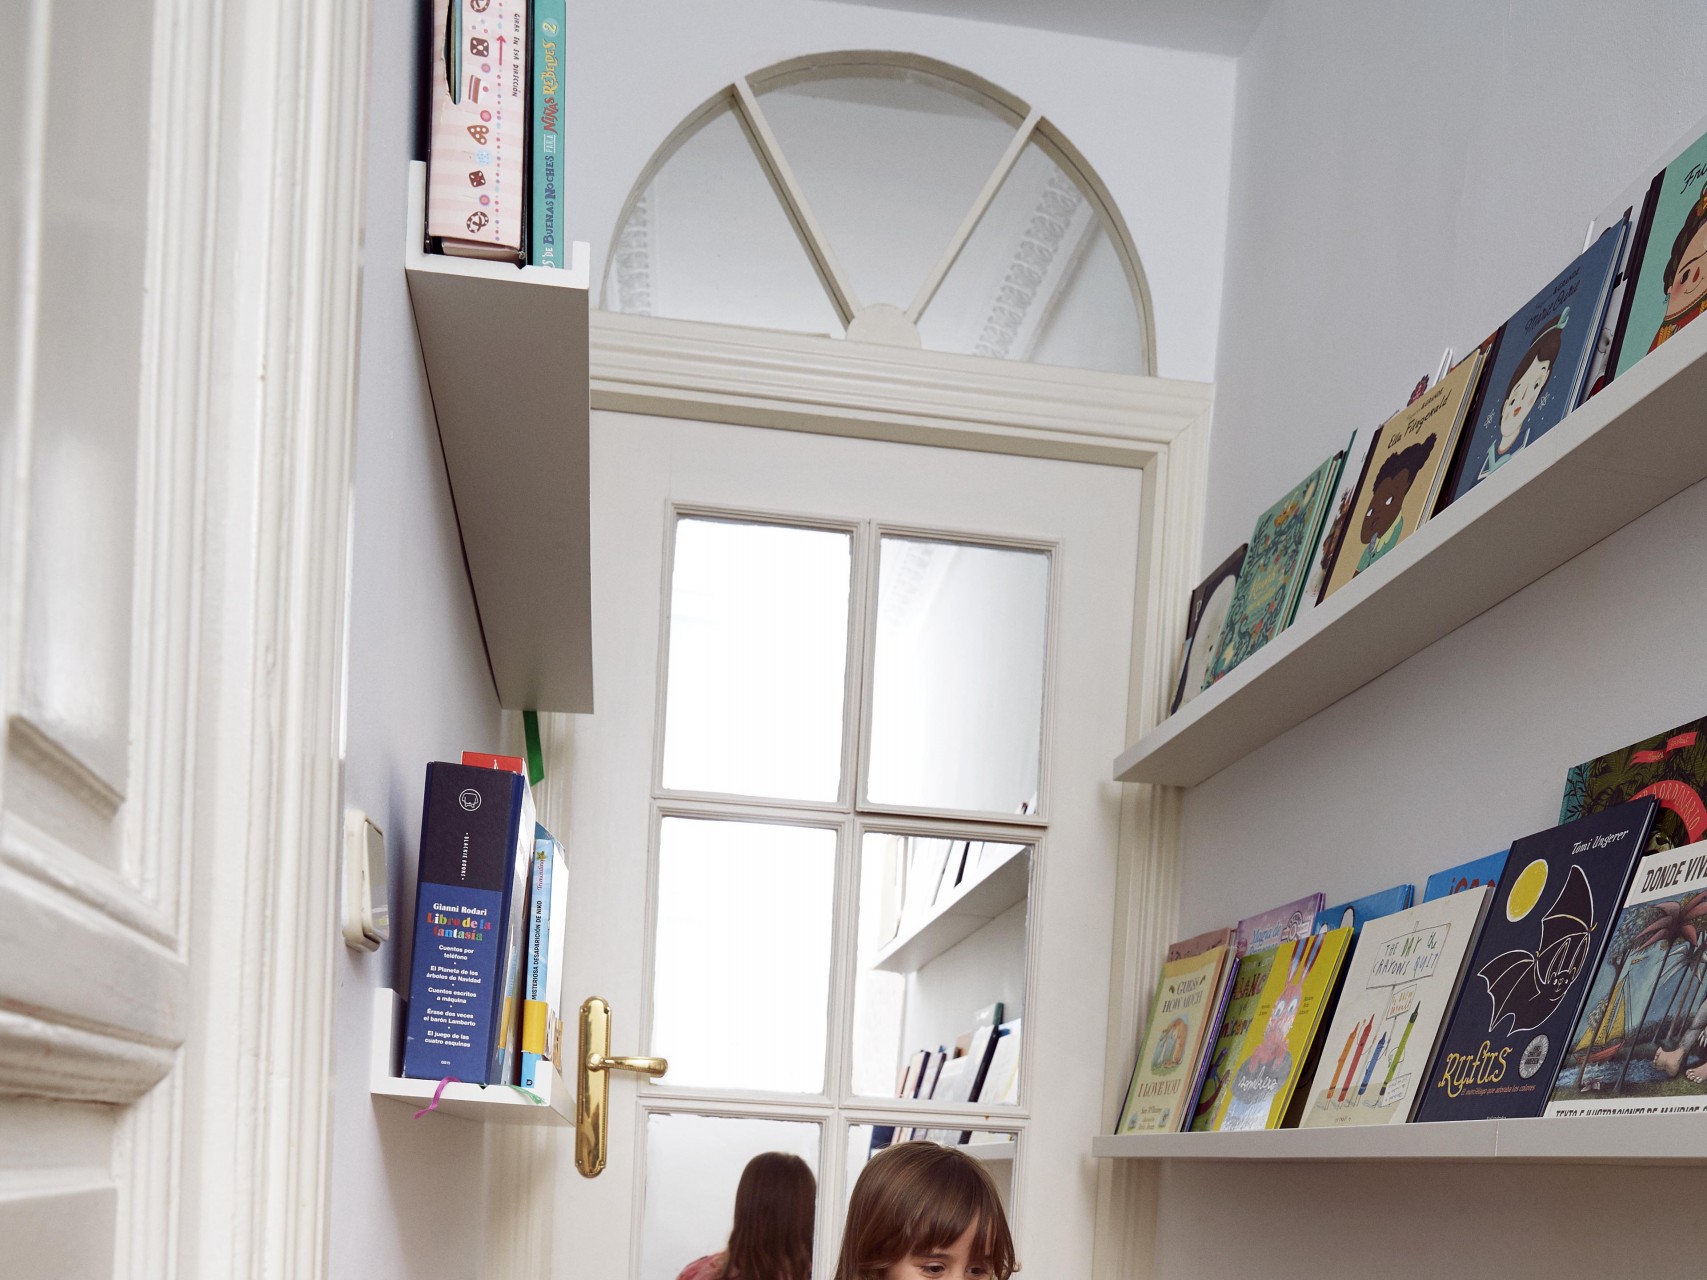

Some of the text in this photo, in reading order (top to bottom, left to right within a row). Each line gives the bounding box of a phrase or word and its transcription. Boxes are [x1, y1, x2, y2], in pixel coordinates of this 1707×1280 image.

[543, 22, 557, 34] 2
[542, 38, 558, 95] REBELDES
[545, 155, 555, 200] NOCHES
[543, 200, 554, 245] BUENAS
[1571, 830, 1629, 855] Tomi Ungerer
[1641, 861, 1687, 894] DONDE
[433, 902, 487, 916] Gianni Rodari
[427, 912, 491, 930] Libro de la
[536, 915, 542, 923] DE
[433, 925, 482, 941] fantasía
[439, 944, 463, 953] Cuentos
[533, 924, 541, 965] DESAPARICIÓN
[1384, 942, 1400, 957] THE
[1401, 936, 1422, 958] DAY
[1372, 953, 1439, 978] CRAYONS QUIT
[458, 976, 482, 984] Navidad
[531, 966, 539, 1001] MISTERIOSA
[1176, 977, 1201, 995] GUESS
[428, 987, 452, 995] Cuentos
[1162, 998, 1183, 1013] HOW
[1438, 1040, 1513, 1098] Rufus
[1143, 1080, 1164, 1097] LOVE
[1163, 1079, 1182, 1095] YOU
